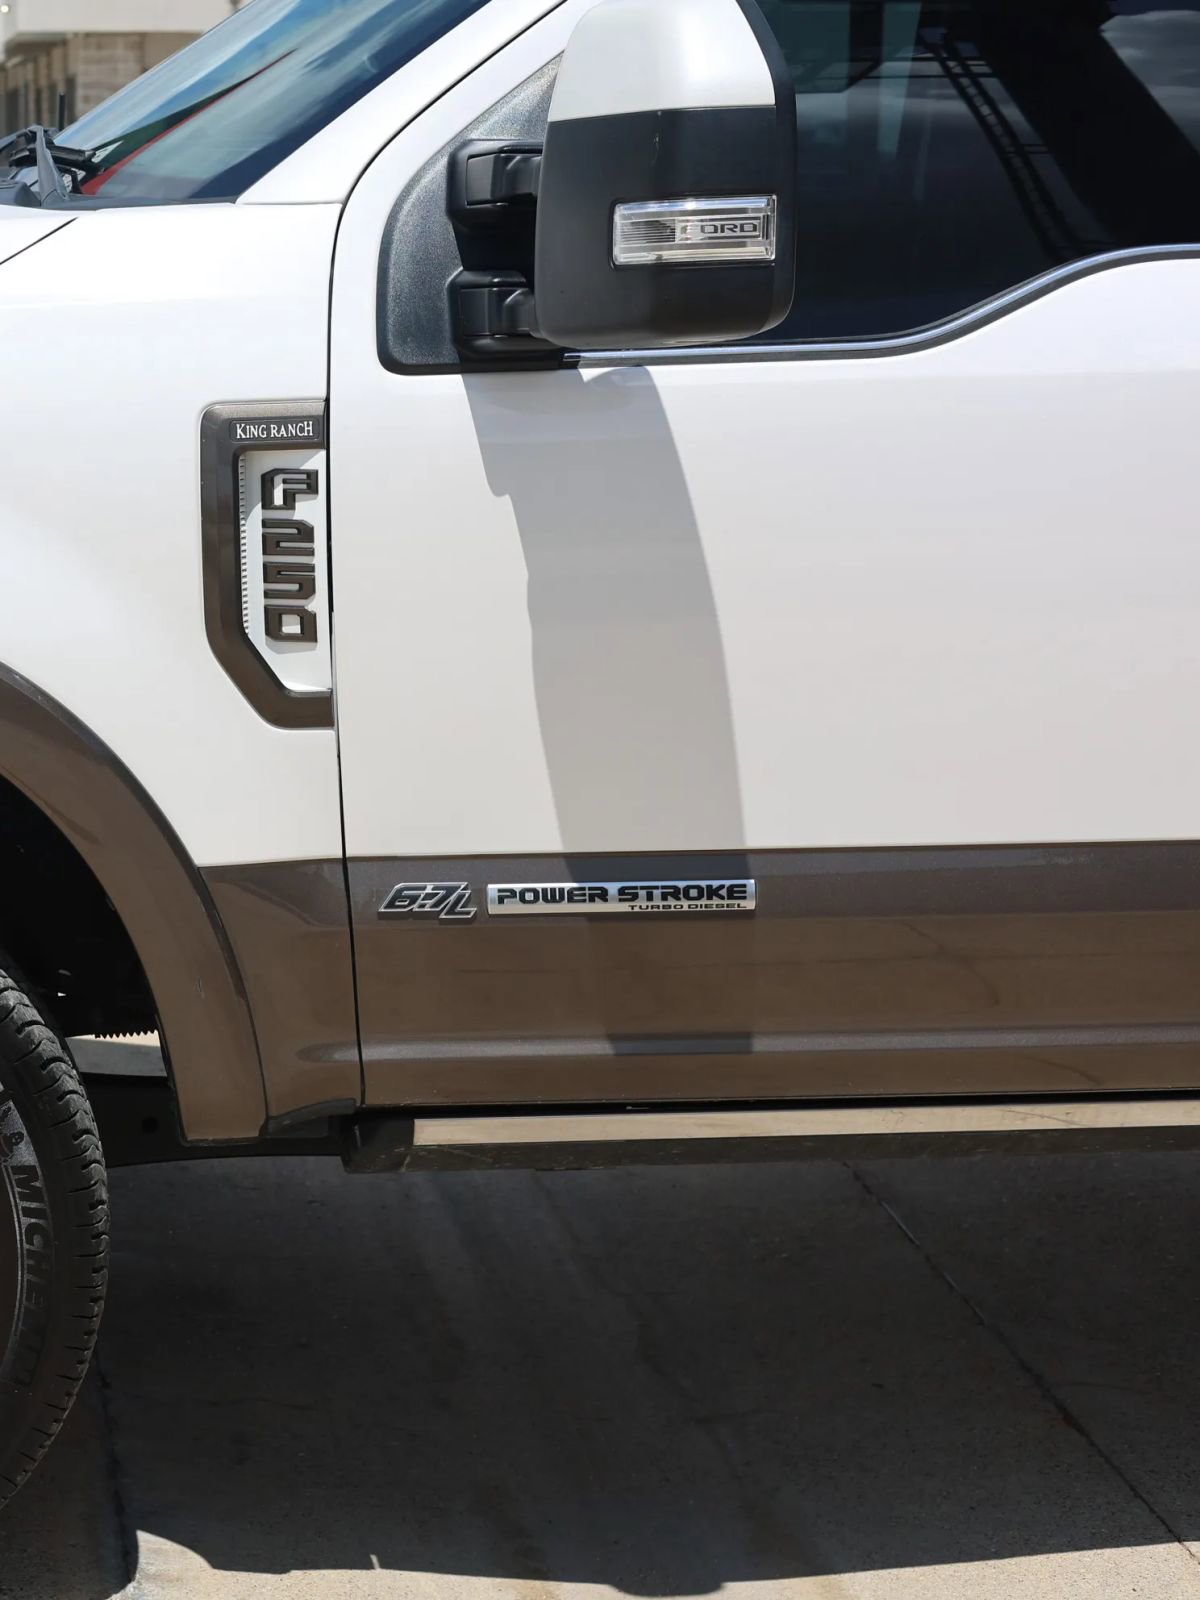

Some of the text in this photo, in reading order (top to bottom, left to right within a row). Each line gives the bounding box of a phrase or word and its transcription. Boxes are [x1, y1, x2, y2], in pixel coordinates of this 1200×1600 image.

[236, 420, 314, 439] KING RANCH
[261, 468, 319, 643] F250
[497, 886, 609, 905] POWER
[618, 883, 748, 903] STROKE
[628, 902, 748, 911] TURBO DIESEL
